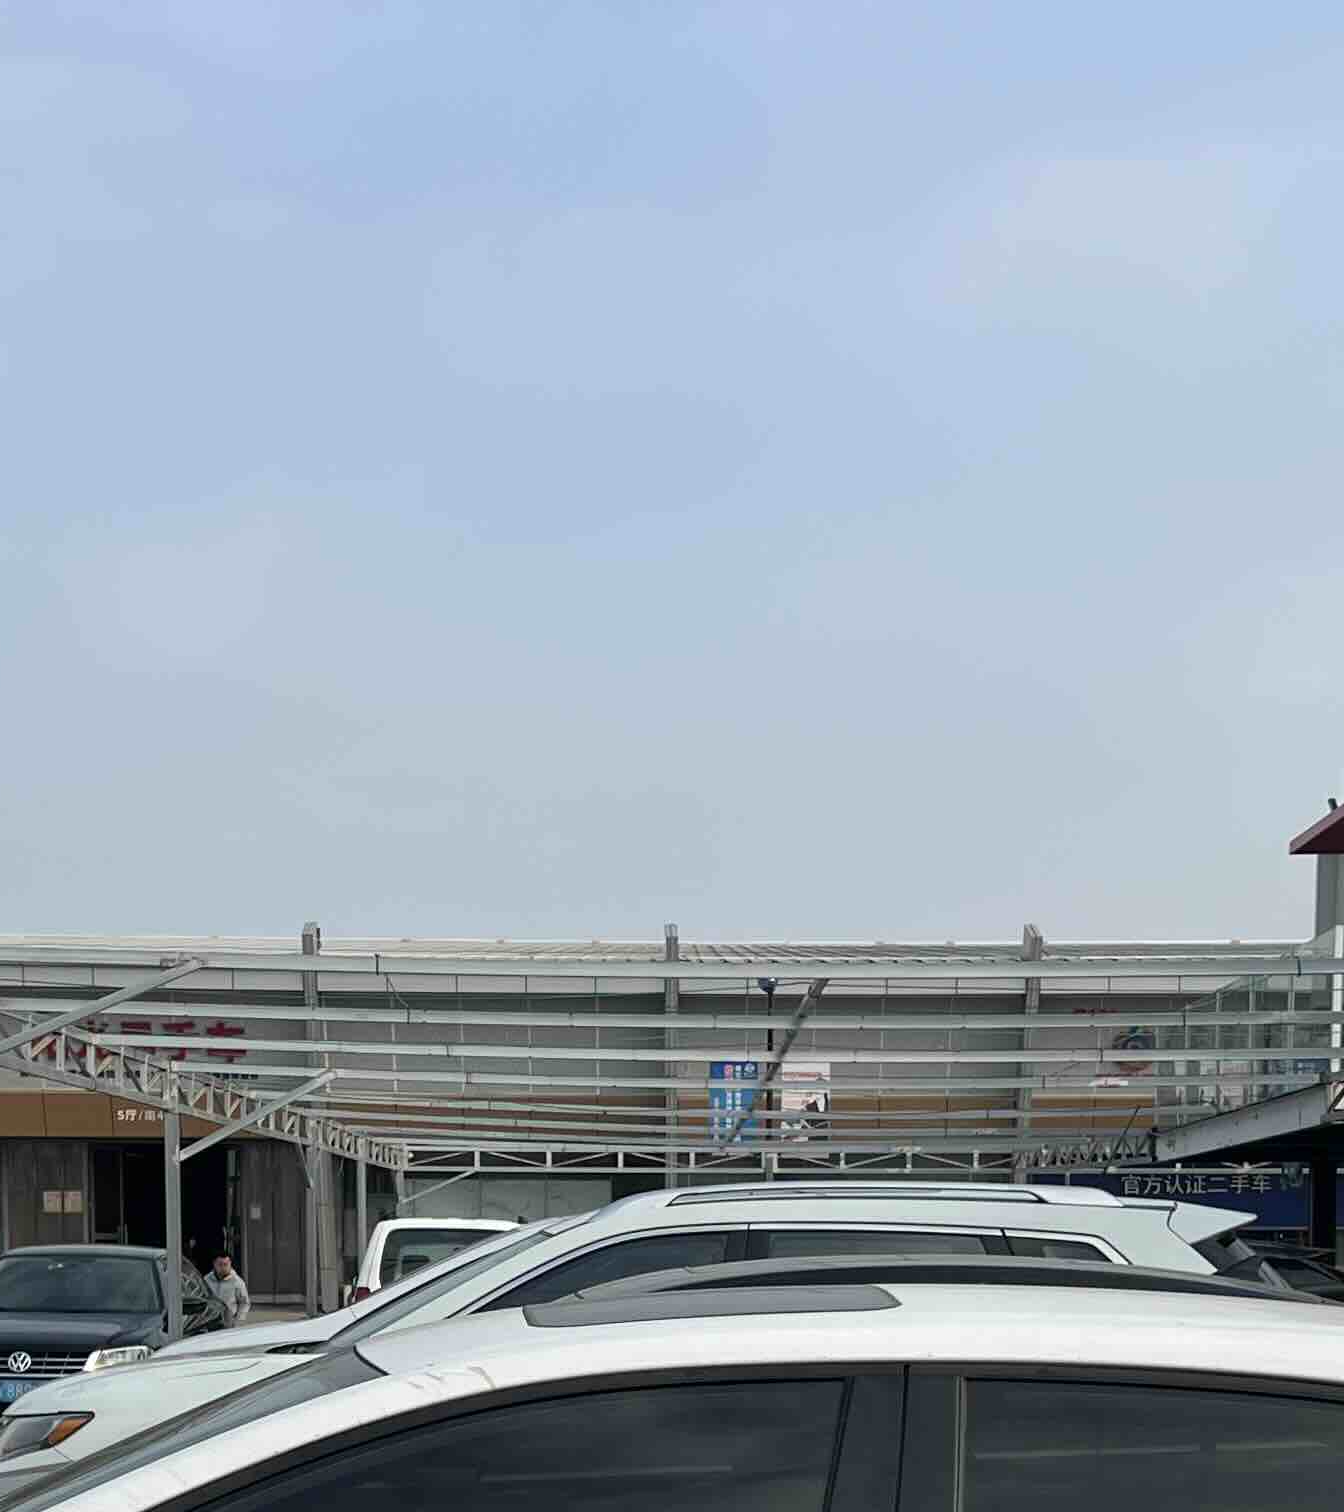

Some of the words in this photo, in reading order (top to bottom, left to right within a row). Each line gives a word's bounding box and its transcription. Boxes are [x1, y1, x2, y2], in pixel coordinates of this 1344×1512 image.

[1120, 1174, 1272, 1195] 官方认证二手车
